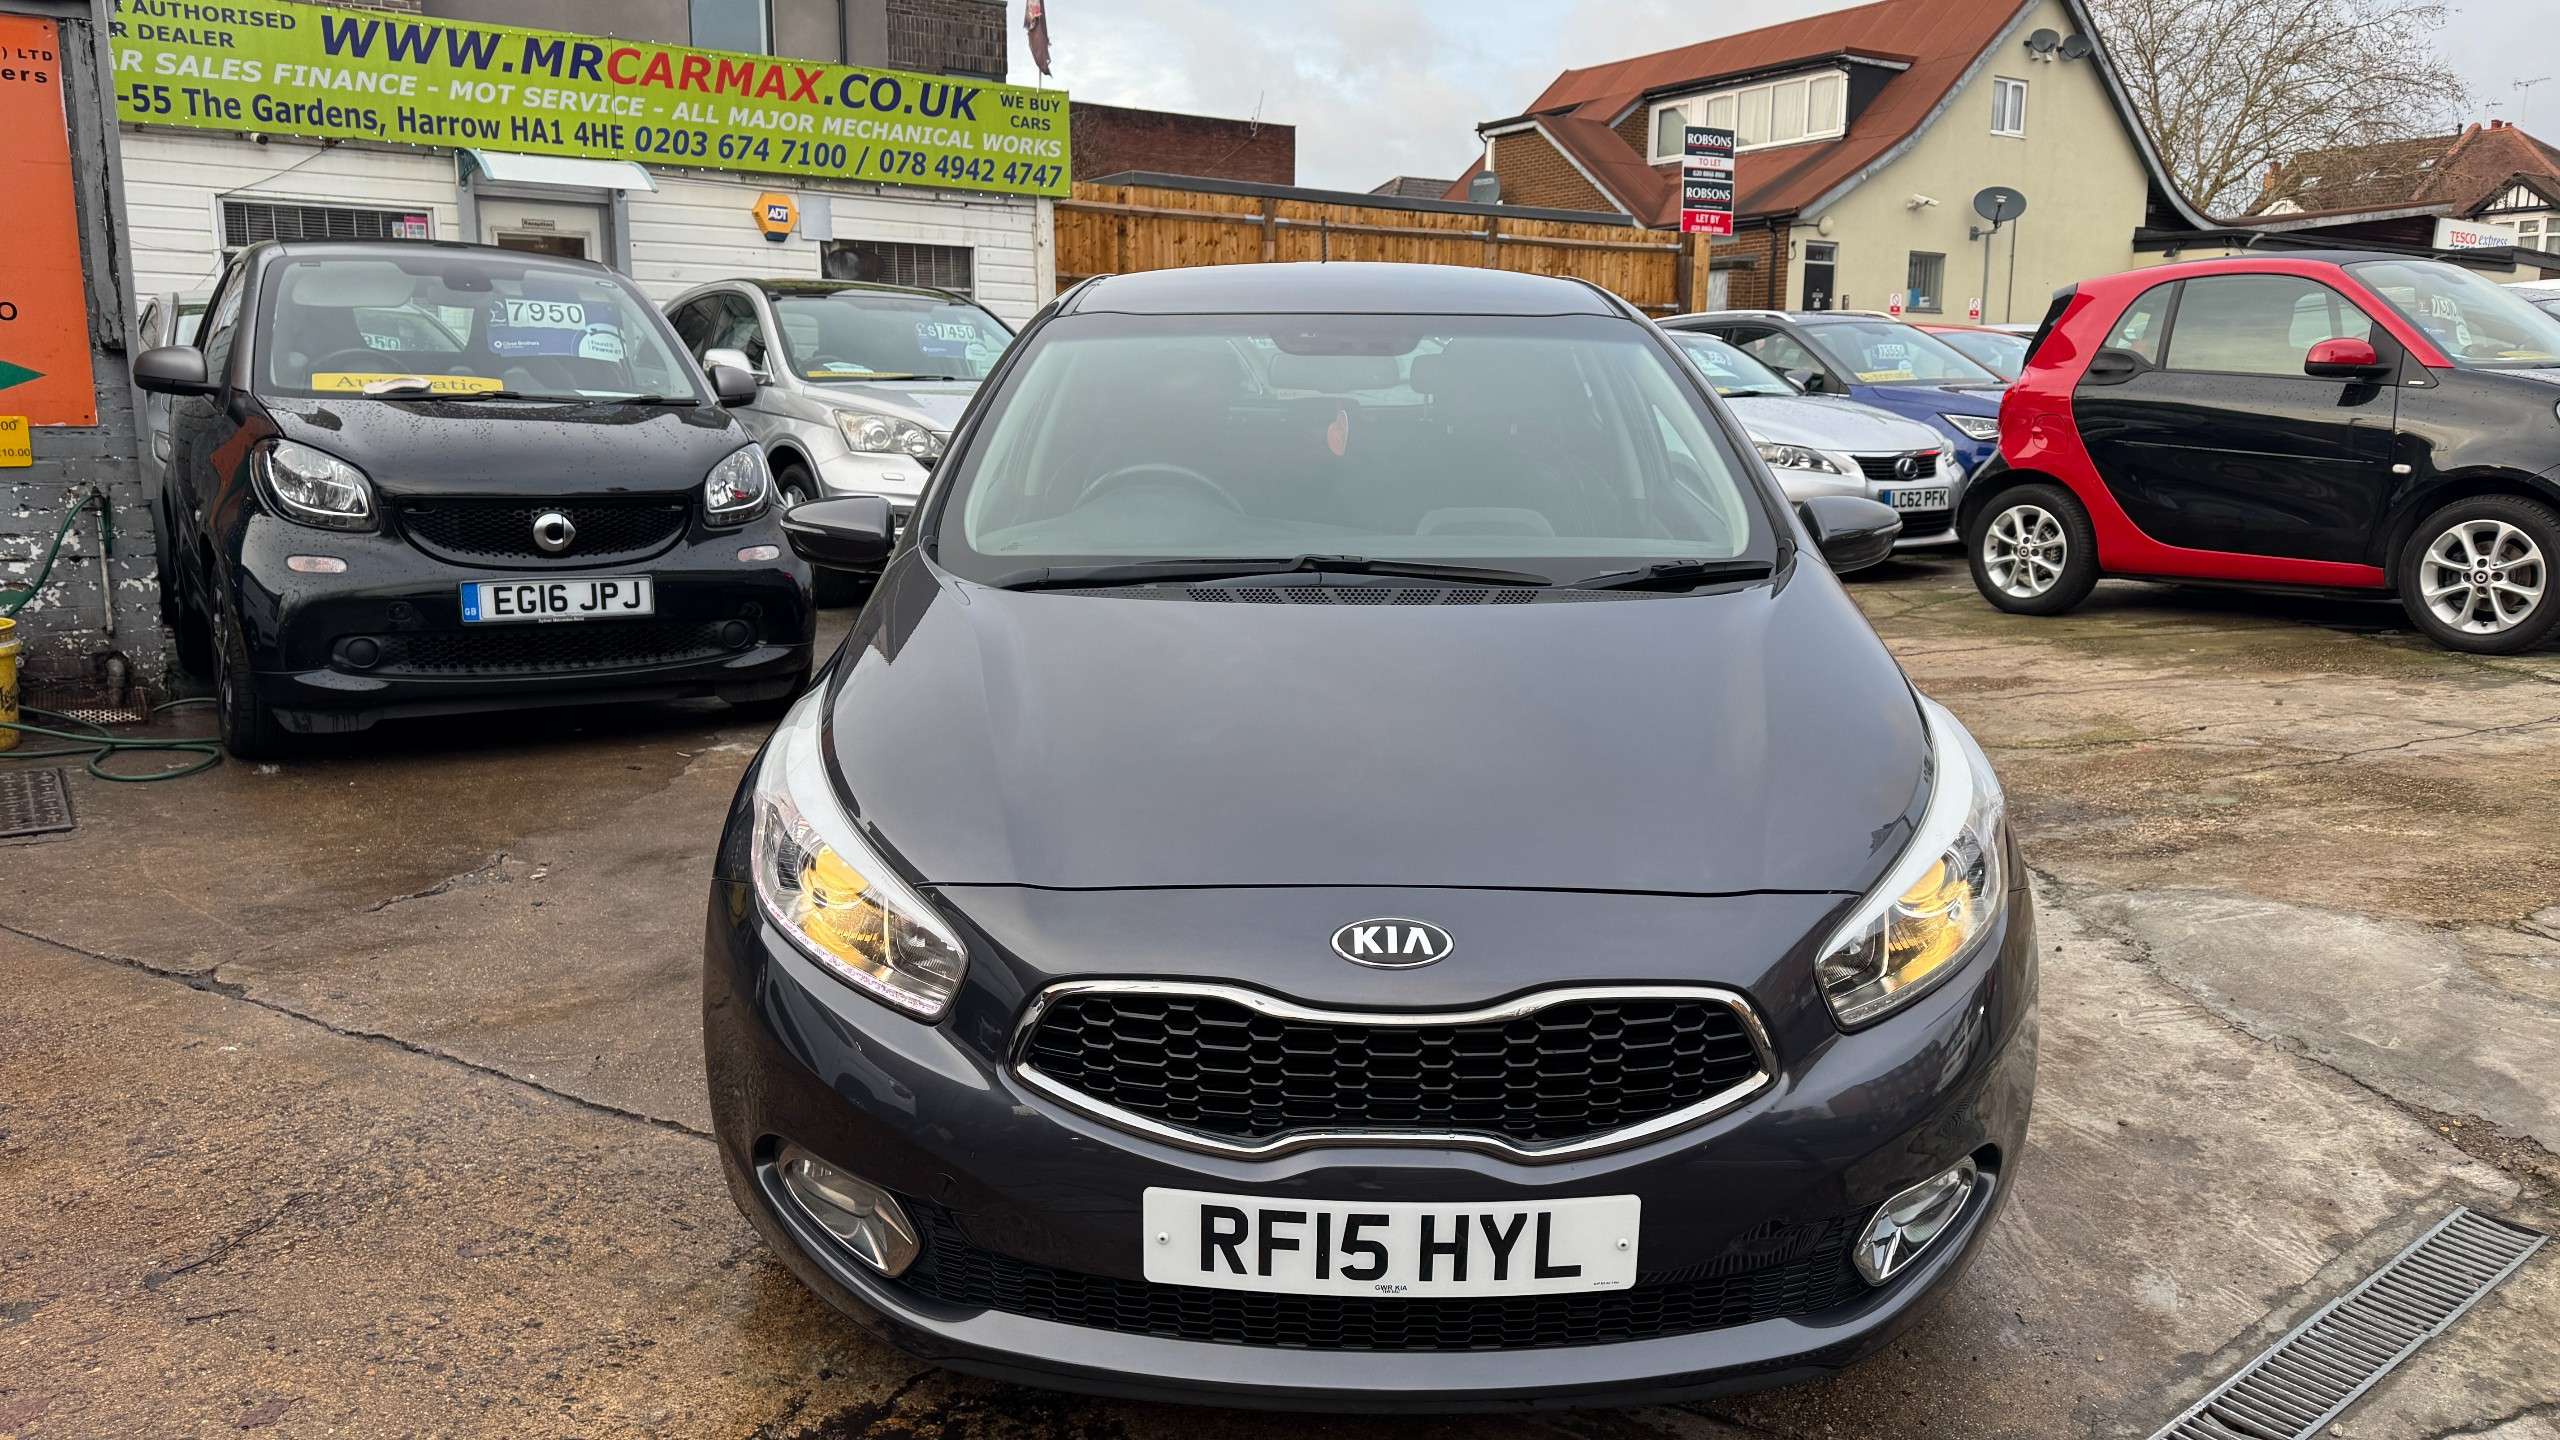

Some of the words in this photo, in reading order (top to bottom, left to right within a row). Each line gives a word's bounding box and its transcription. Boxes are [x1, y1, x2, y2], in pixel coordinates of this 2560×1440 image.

[131, 0, 297, 30] AUTHORISED
[138, 23, 236, 48] DEALER
[17, 48, 53, 61] LTD
[321, 15, 981, 122] WWW.MRCARMAX.CO.UK
[154, 52, 262, 83] SALES
[274, 63, 417, 96] FINANCE
[449, 79, 516, 105] MOT
[523, 86, 646, 117] SERVICE
[672, 101, 719, 124] ALL
[728, 106, 814, 133] MAJOR
[822, 116, 974, 149] MECHANICAL
[982, 132, 1062, 158] WORKS
[1000, 94, 1024, 109] WE
[1029, 97, 1061, 113] BUY
[1010, 115, 1051, 131] CARS
[181, 87, 242, 120] The
[252, 93, 386, 137] Gardens,
[397, 105, 501, 140] Harrow
[511, 115, 564, 145] HA1
[574, 121, 624, 150] 4HE
[635, 126, 708, 157] 0203
[718, 133, 769, 162] 674
[780, 139, 847, 170] 7100
[879, 149, 927, 176] 078
[935, 154, 995, 183] 4942
[1003, 161, 1063, 188] 4747
[1687, 133, 1732, 147] ROBSONS
[1699, 158, 1709, 166] TO
[1710, 159, 1721, 167] LET
[1686, 187, 1731, 200] ROBSONS
[768, 207, 788, 220] ADT
[1695, 213, 1709, 223] LET
[1710, 214, 1720, 224] BY
[2449, 231, 2477, 244] TESCO
[0, 448, 30, 457] 10.00
[1891, 492, 1922, 508] LC62
[1924, 490, 1946, 506] PFK
[493, 584, 568, 615] EG16
[579, 581, 640, 611] JPJ
[1352, 926, 1434, 955] KIA
[1200, 1204, 1390, 1281] RF15
[1419, 1211, 1582, 1282] HYL
